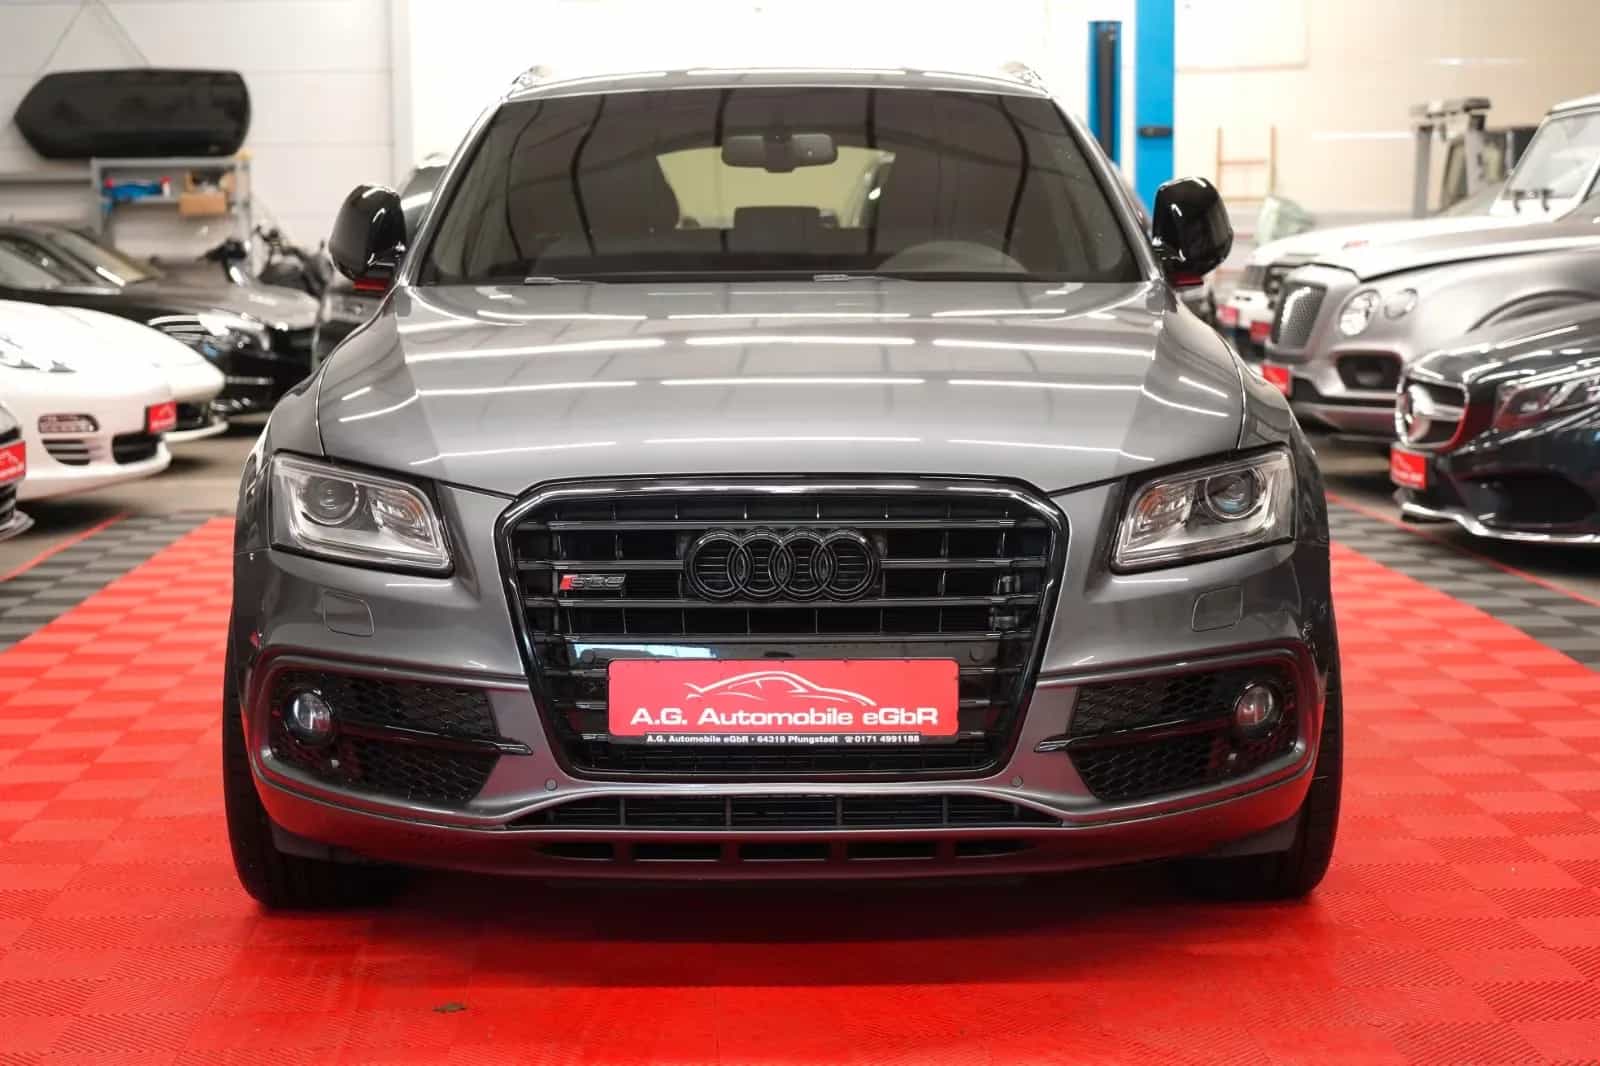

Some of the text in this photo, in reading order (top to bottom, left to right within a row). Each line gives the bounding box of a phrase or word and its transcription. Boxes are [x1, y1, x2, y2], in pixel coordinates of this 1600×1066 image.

[630, 707, 938, 725] A.G. Automobile eGbR
[646, 735, 665, 743] A.G.
[669, 735, 720, 743] Automobile
[723, 735, 748, 743] eGbR
[788, 735, 838, 744] Pfungstadt
